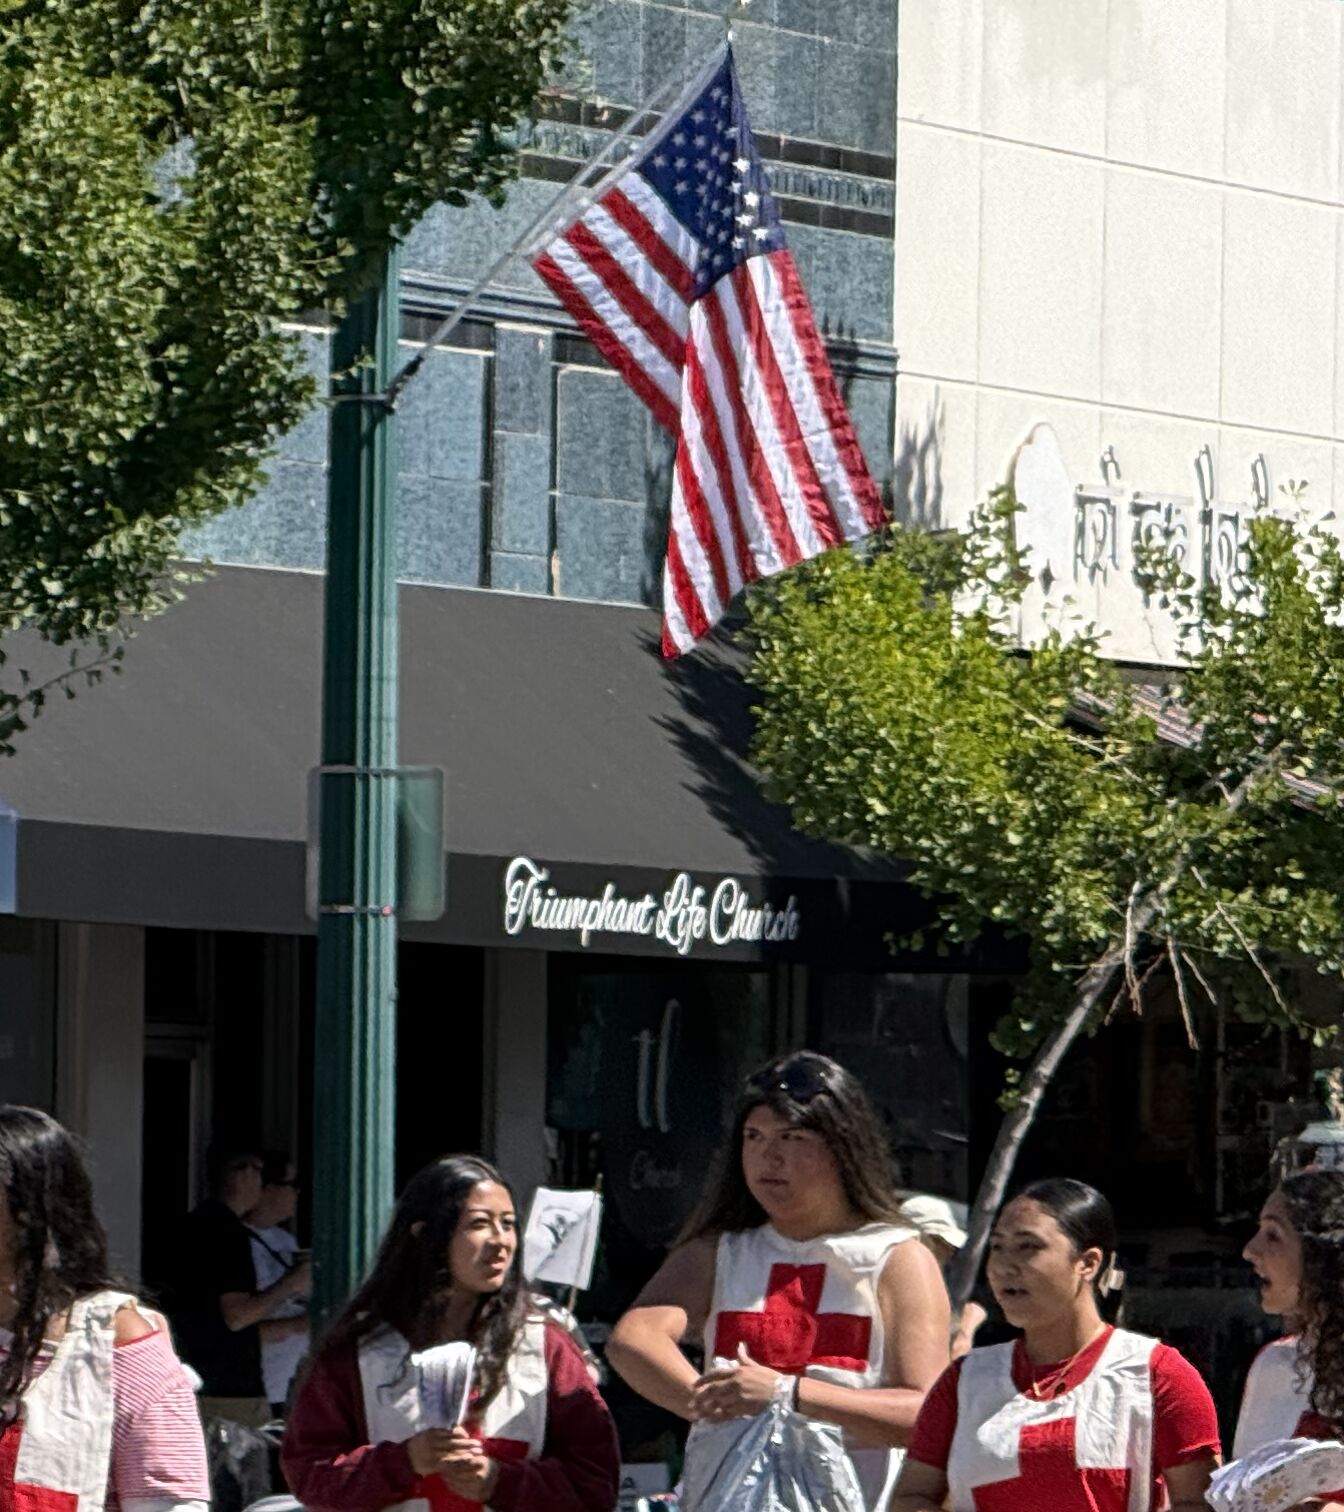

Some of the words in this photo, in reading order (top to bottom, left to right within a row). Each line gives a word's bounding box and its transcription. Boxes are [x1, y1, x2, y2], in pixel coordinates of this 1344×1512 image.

[505, 855, 658, 947] Triumphant
[655, 872, 708, 956] Life
[710, 876, 800, 945] Church
